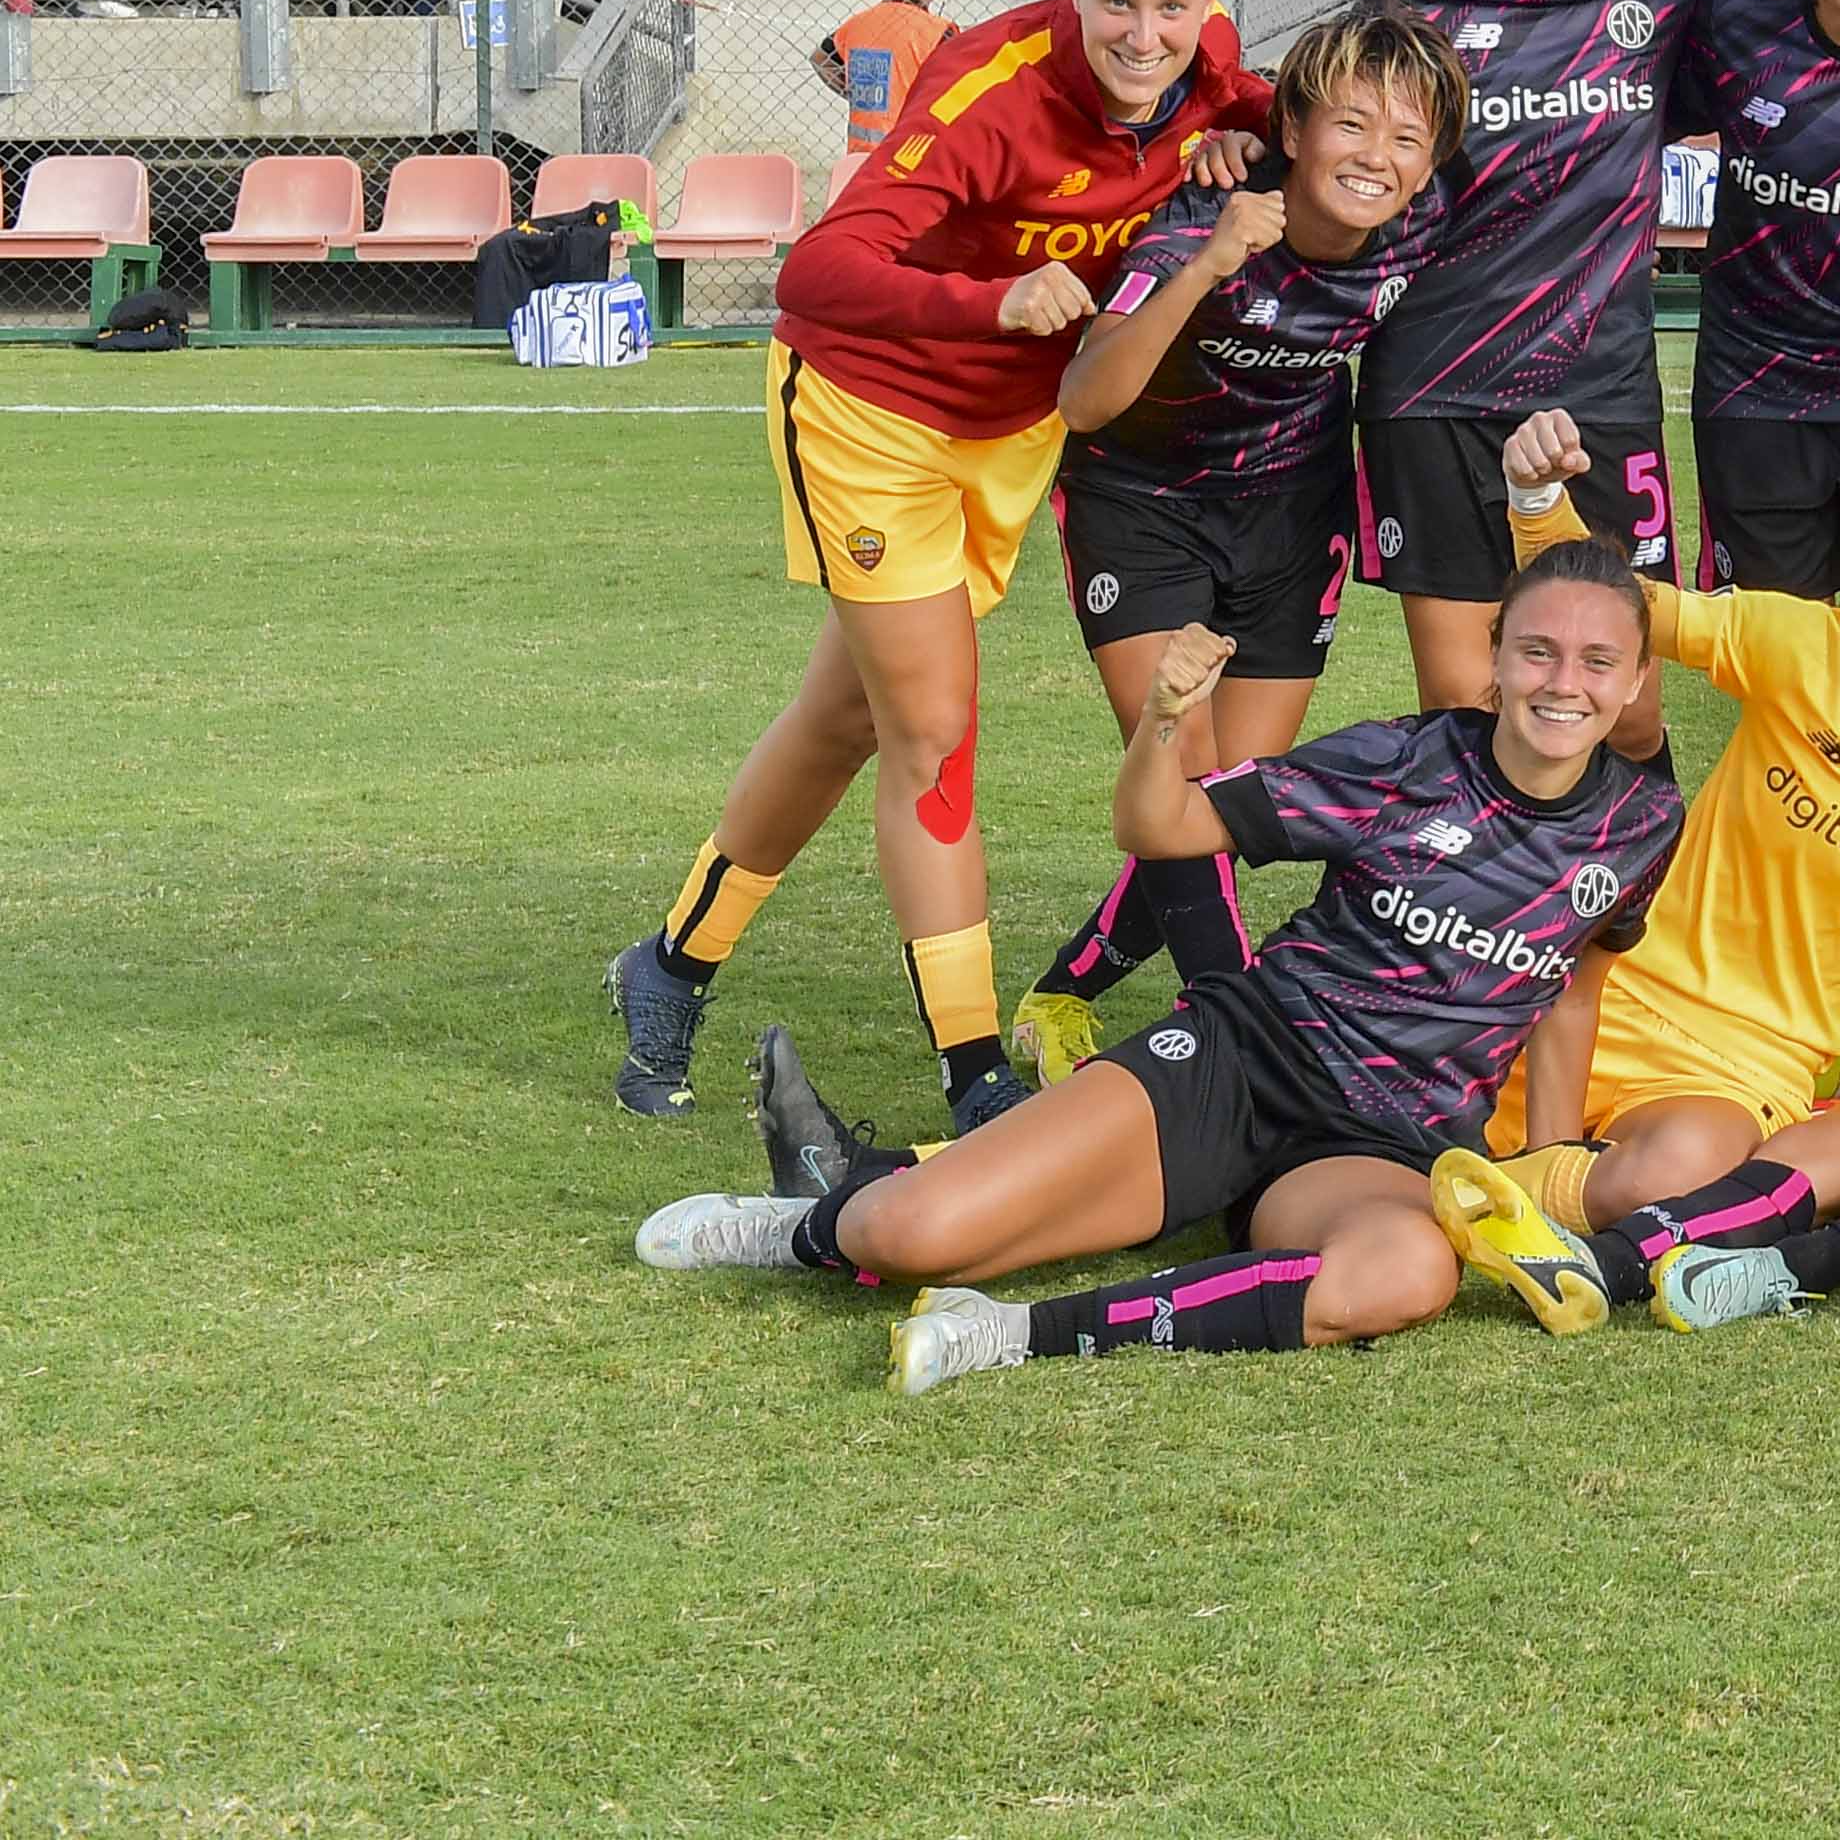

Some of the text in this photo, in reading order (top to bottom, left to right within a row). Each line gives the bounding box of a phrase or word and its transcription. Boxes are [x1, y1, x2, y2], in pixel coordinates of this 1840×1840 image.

[1607, 1, 1654, 48] ASR
[1468, 72, 1654, 126] igitalbits
[1625, 452, 1666, 537] 5
[1571, 863, 1620, 918] ASR
[1371, 886, 1576, 982] digitalbits
